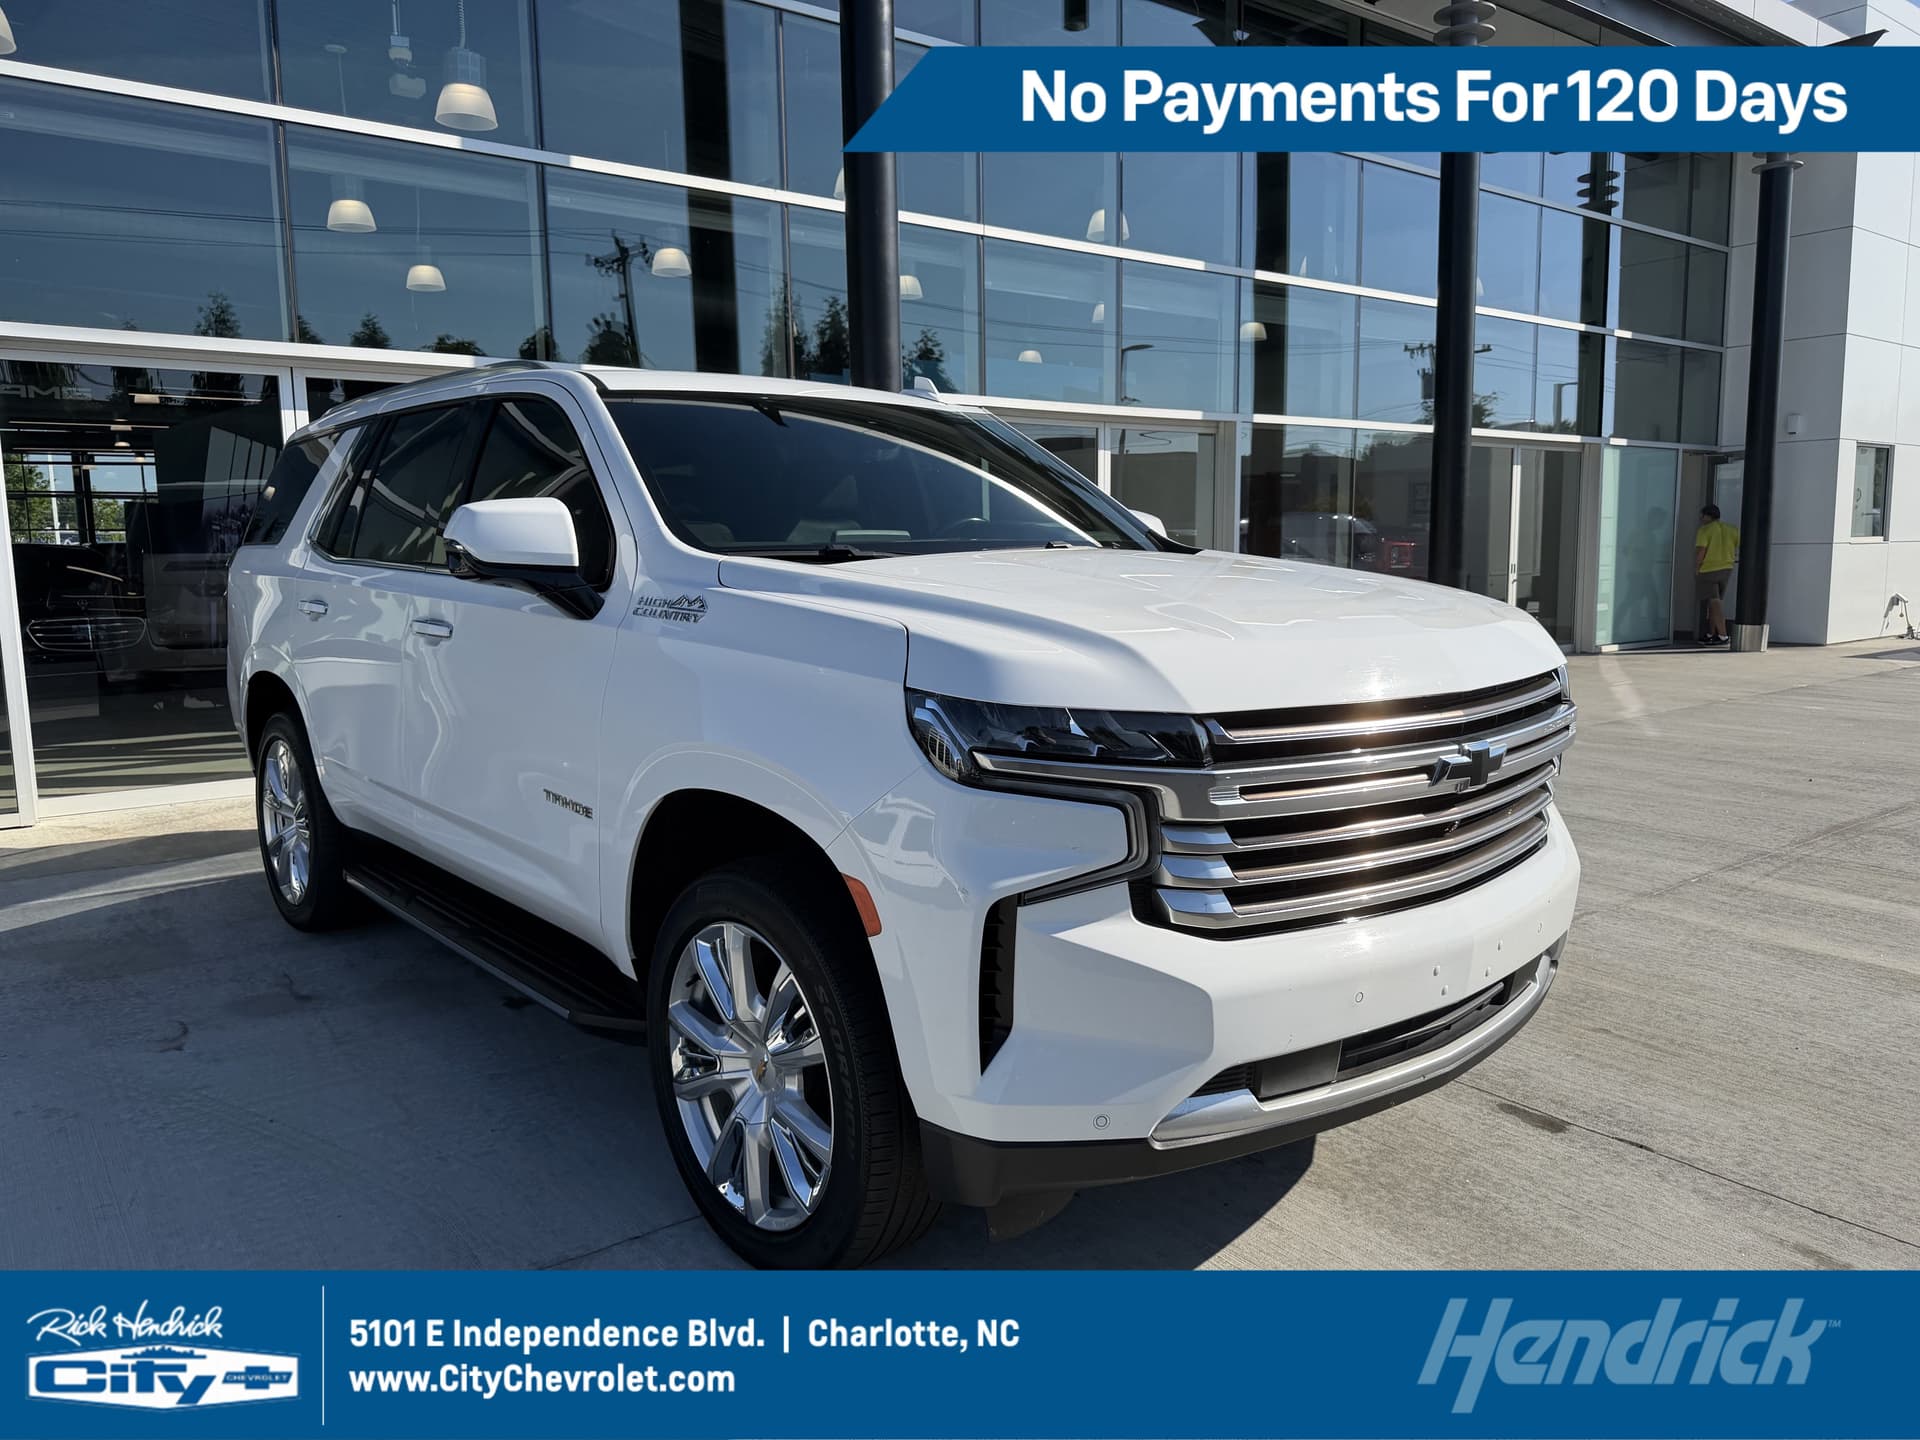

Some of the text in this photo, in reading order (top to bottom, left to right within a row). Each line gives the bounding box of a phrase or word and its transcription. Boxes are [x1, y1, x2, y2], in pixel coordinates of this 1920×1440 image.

[638, 597, 672, 608] HIGH
[632, 607, 700, 624] COUNTRY
[543, 788, 593, 819] TAHOE
